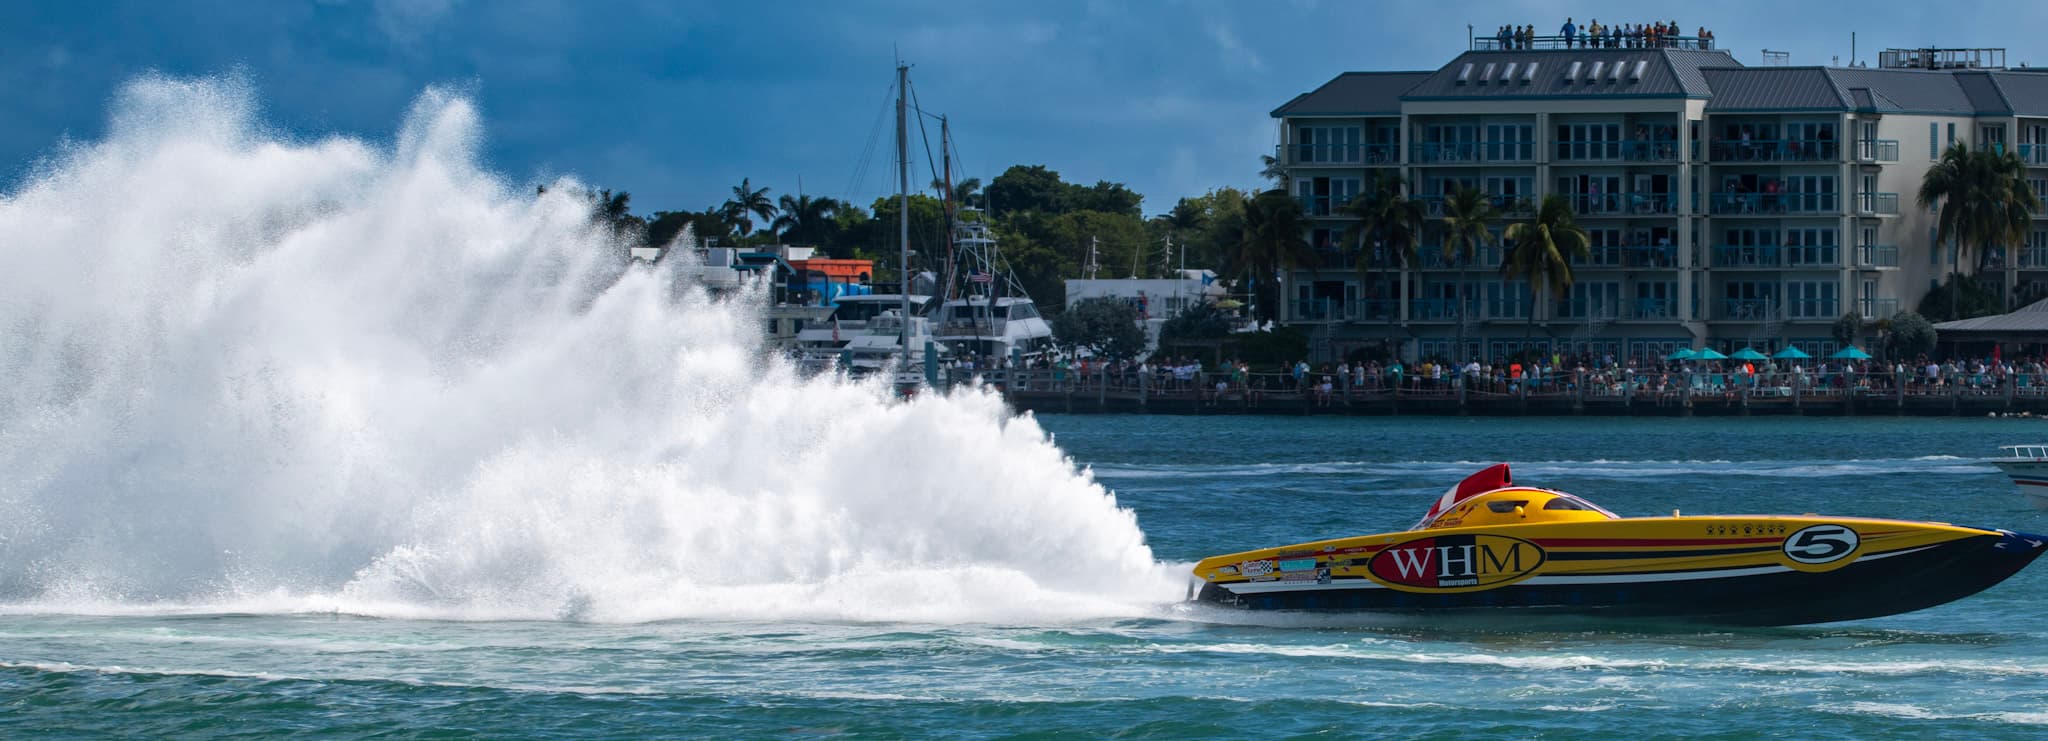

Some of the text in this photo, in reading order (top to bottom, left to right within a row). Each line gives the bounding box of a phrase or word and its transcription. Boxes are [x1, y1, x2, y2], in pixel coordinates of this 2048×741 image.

[1790, 529, 1850, 559] 5
[1389, 543, 1524, 580] WHM
[1439, 577, 1478, 588] Motorsports
